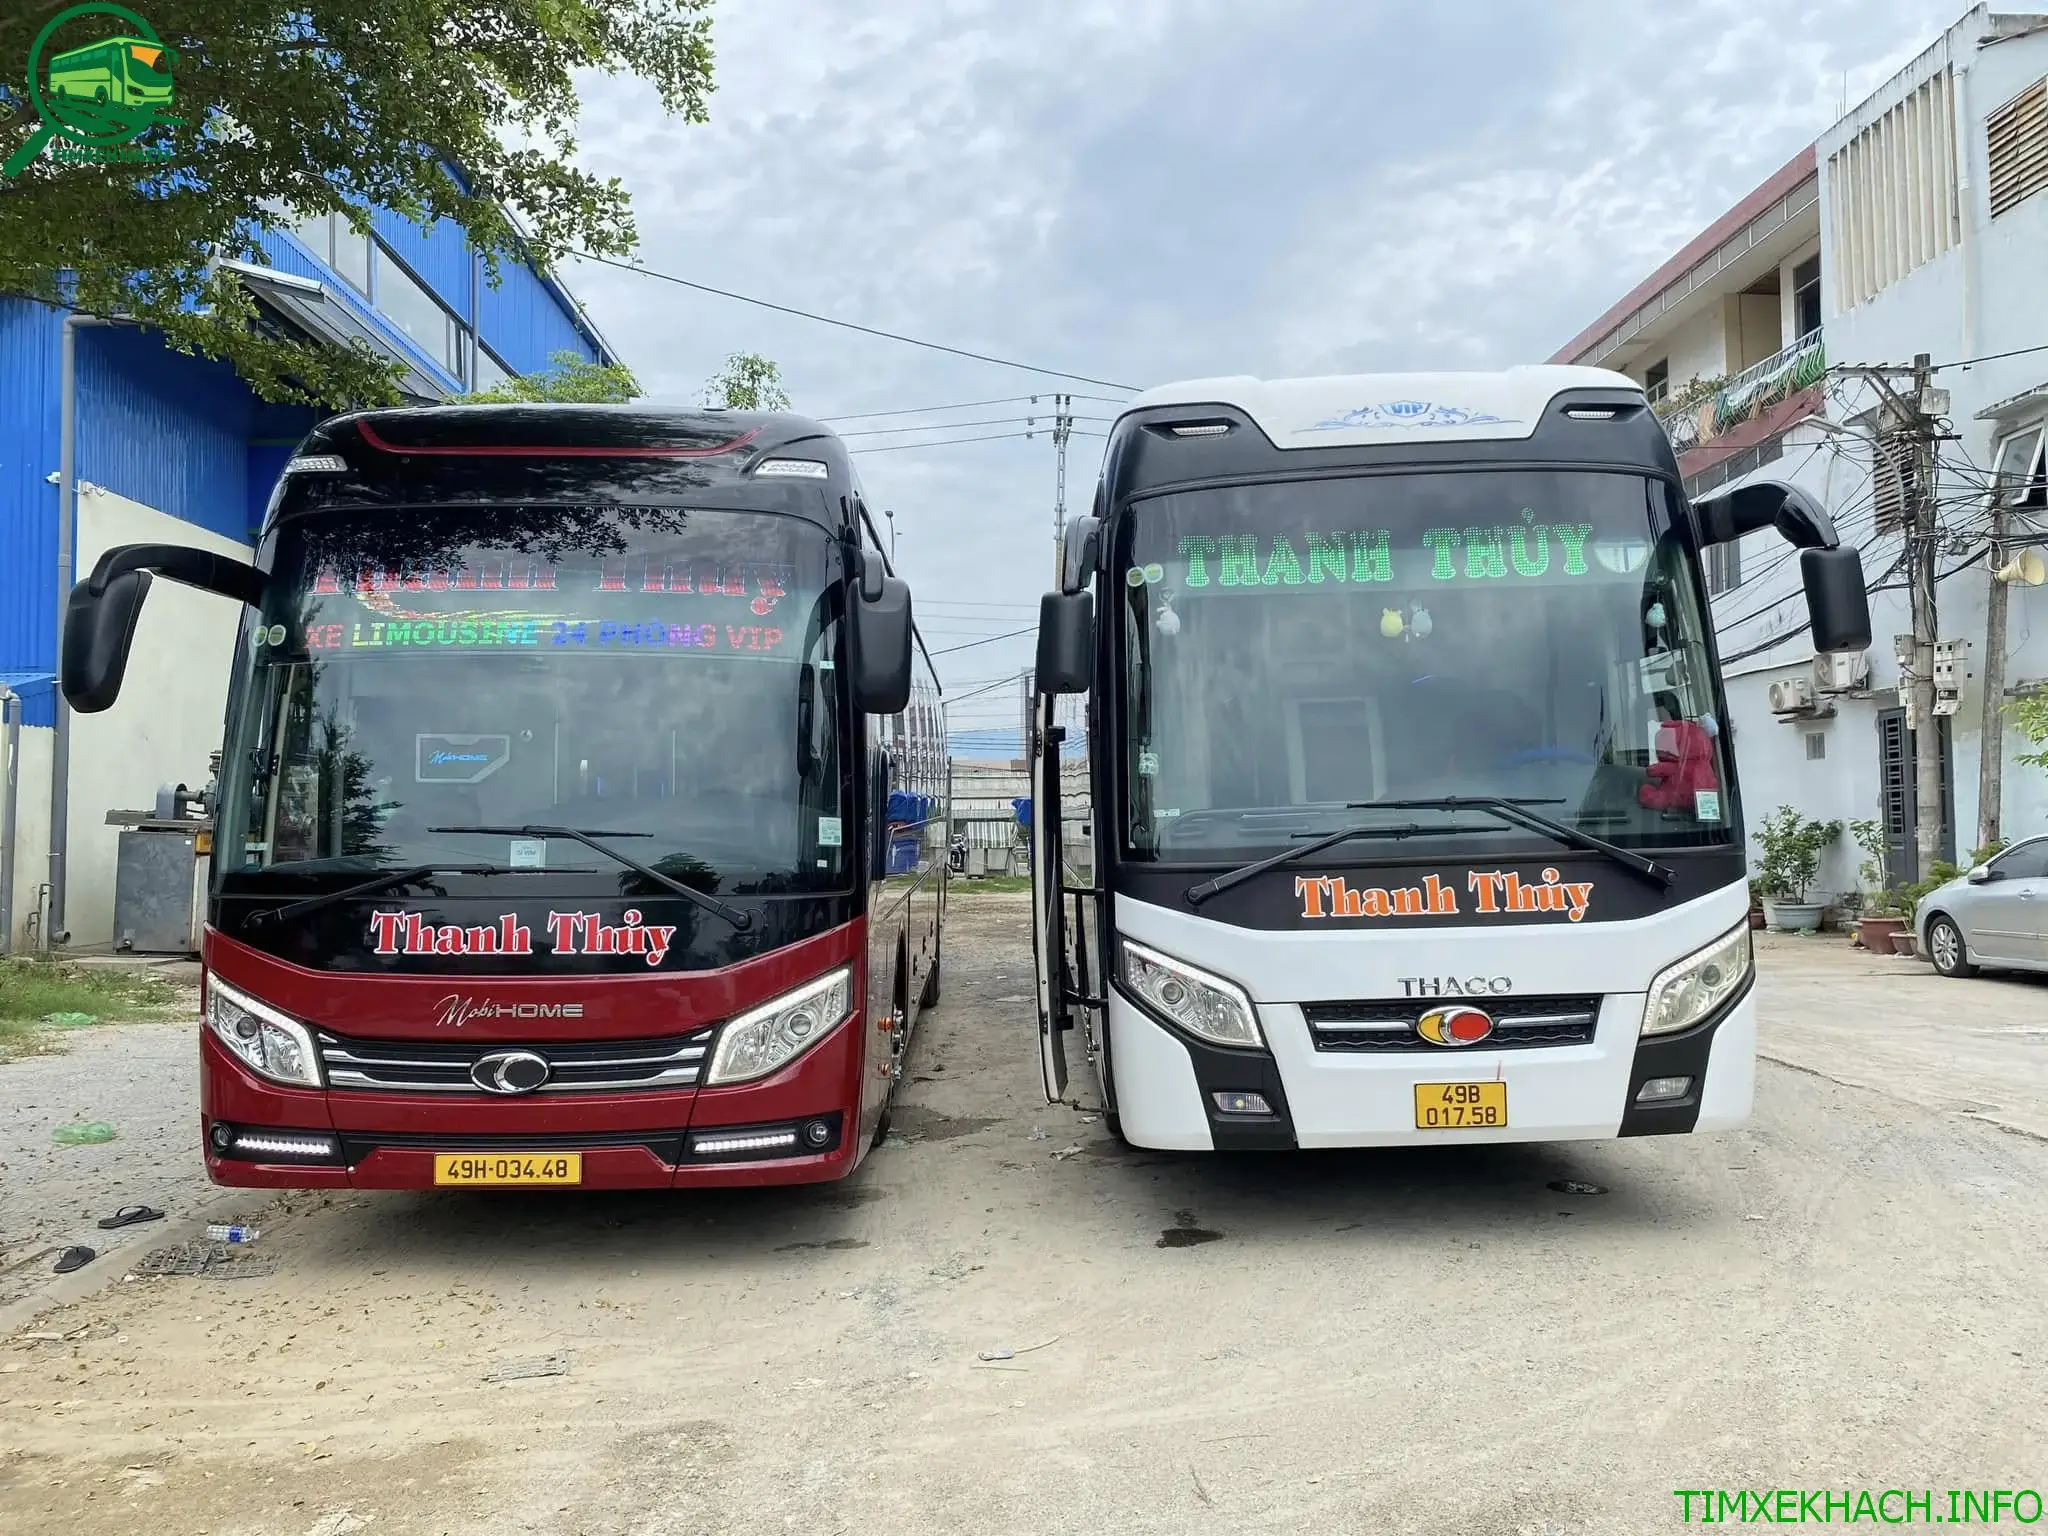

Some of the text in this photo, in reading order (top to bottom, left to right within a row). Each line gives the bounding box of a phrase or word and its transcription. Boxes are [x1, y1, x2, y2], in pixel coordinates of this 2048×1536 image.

[1391, 404, 1423, 414] VIP
[1177, 506, 1593, 587] THANH THỦY
[351, 619, 538, 648] LIMOUSINE
[552, 621, 588, 647] 24
[725, 624, 784, 650] VIP
[1295, 867, 1594, 922] Thanh Thủy
[370, 909, 676, 966] Thanh Thủy
[1397, 976, 1512, 997] THACO
[1441, 1085, 1481, 1104] 49B
[1426, 1106, 1497, 1126] 017.58
[447, 1160, 568, 1179] 49H-034.48
